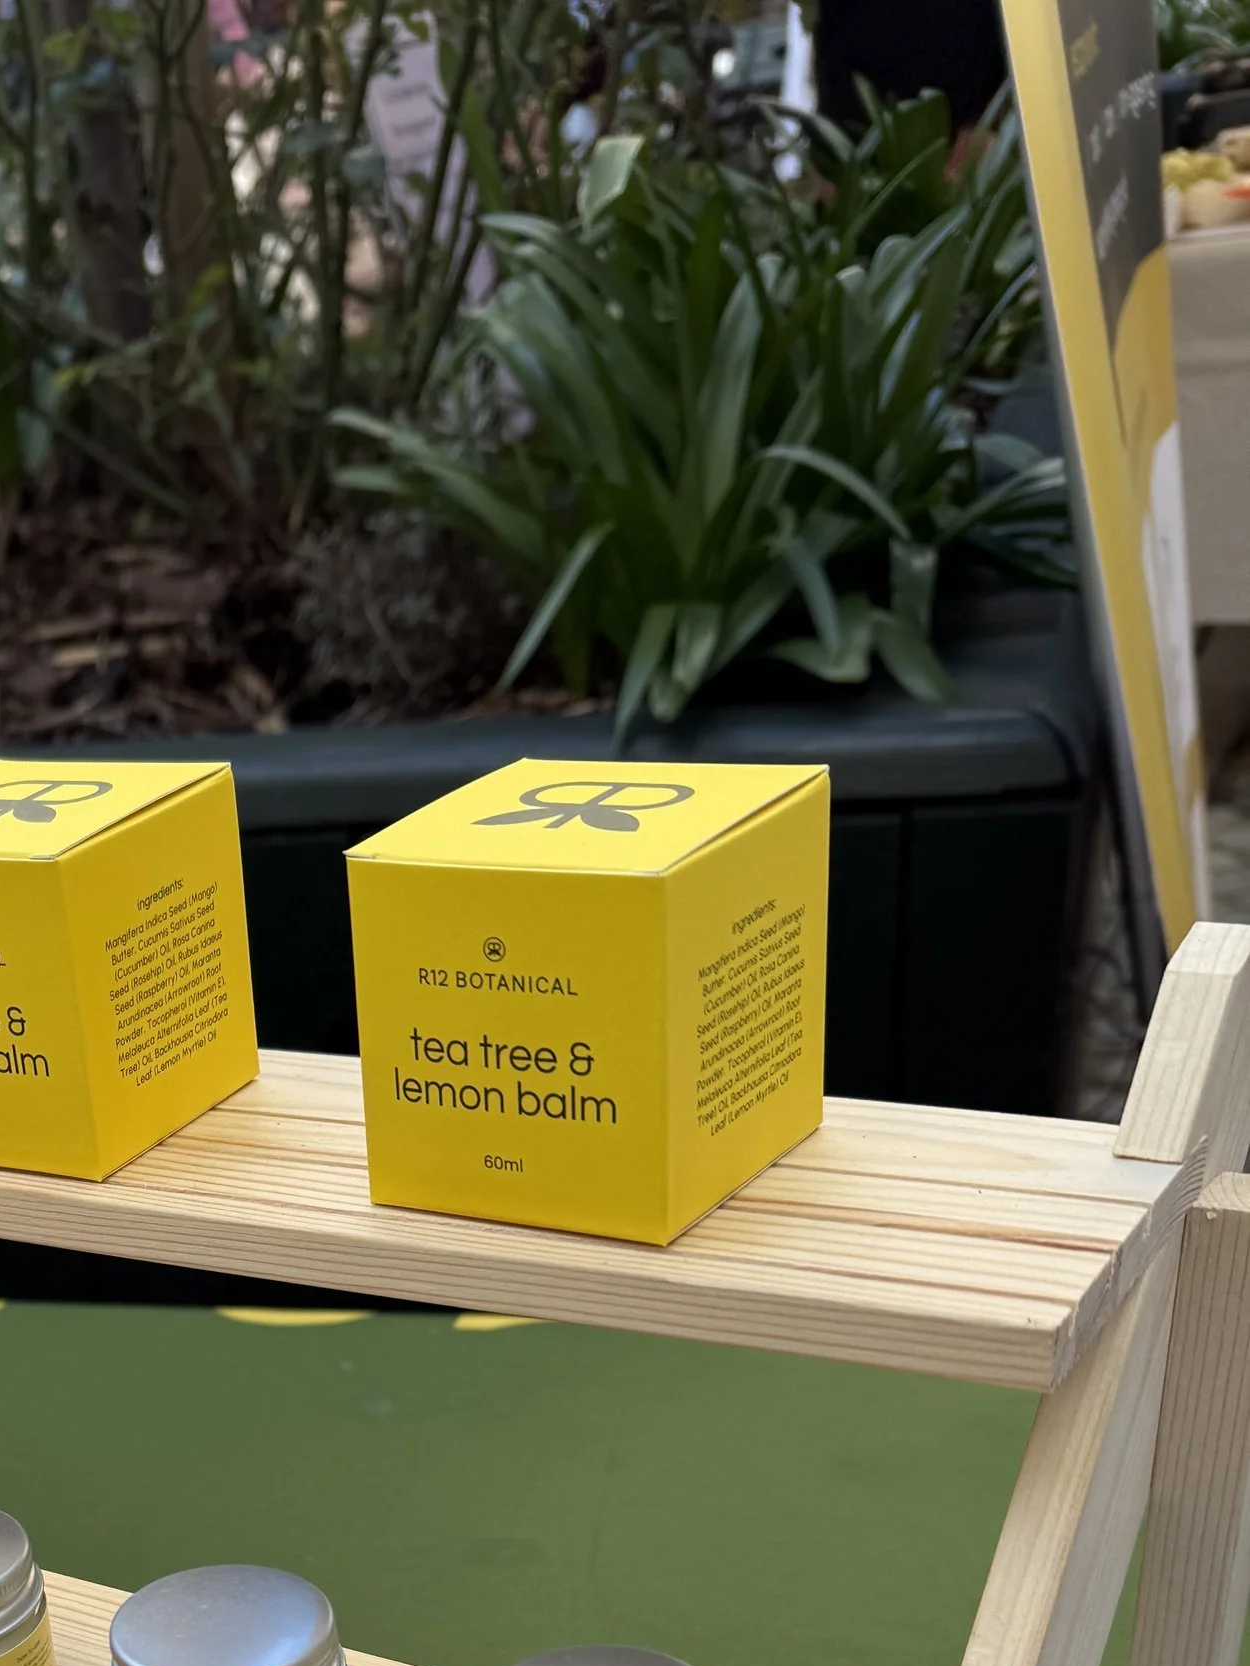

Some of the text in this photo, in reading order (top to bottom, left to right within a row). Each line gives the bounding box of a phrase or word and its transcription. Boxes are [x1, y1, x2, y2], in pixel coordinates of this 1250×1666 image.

[418, 968, 578, 995] R12 BOTANICAL
[8, 1007, 26, 1036] &
[410, 1028, 595, 1076] tea tree &
[395, 1068, 617, 1124] lemon balm
[484, 1155, 523, 1173] 60ml
